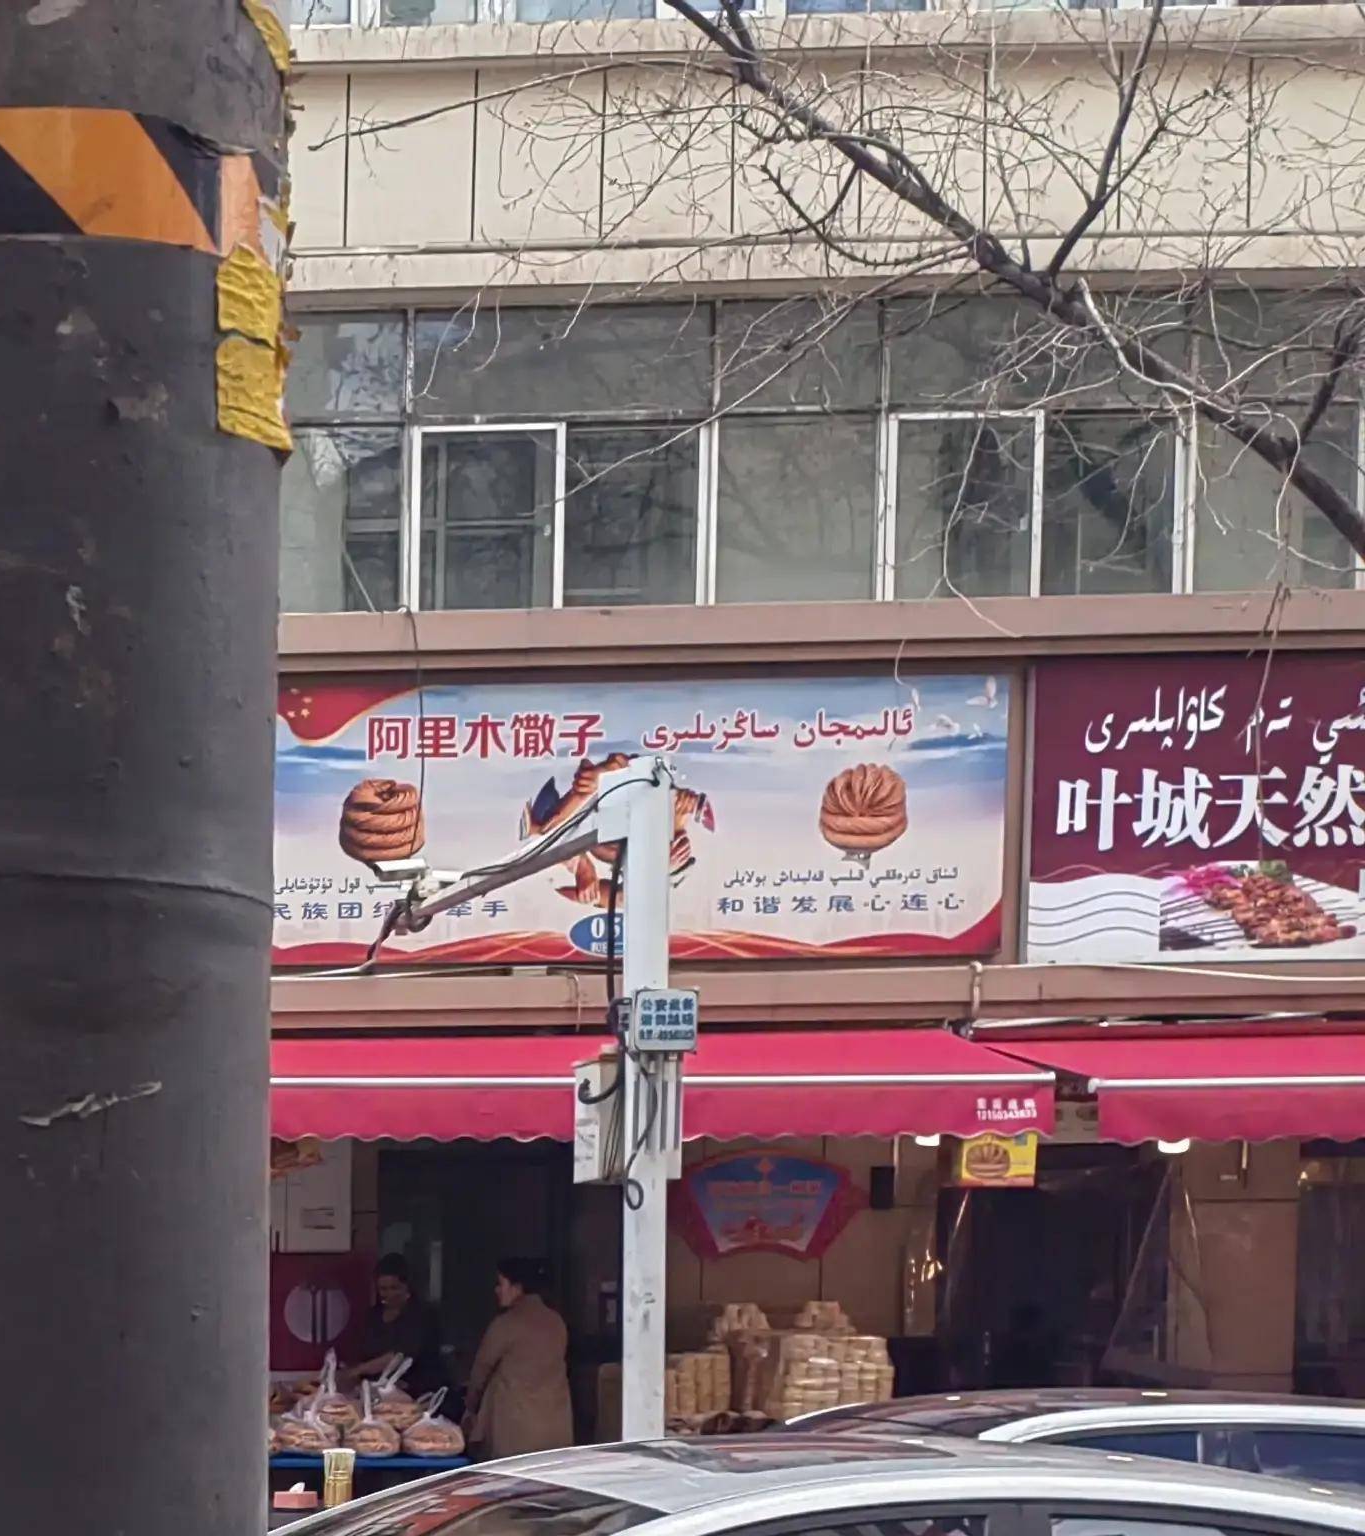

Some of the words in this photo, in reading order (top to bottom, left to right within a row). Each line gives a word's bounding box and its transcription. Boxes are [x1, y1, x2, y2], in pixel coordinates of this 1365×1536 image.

[368, 714, 604, 760] 阿里木馓子
[1056, 764, 1365, 851] 叶城天然
[716, 892, 966, 915] 和谐发展心连心
